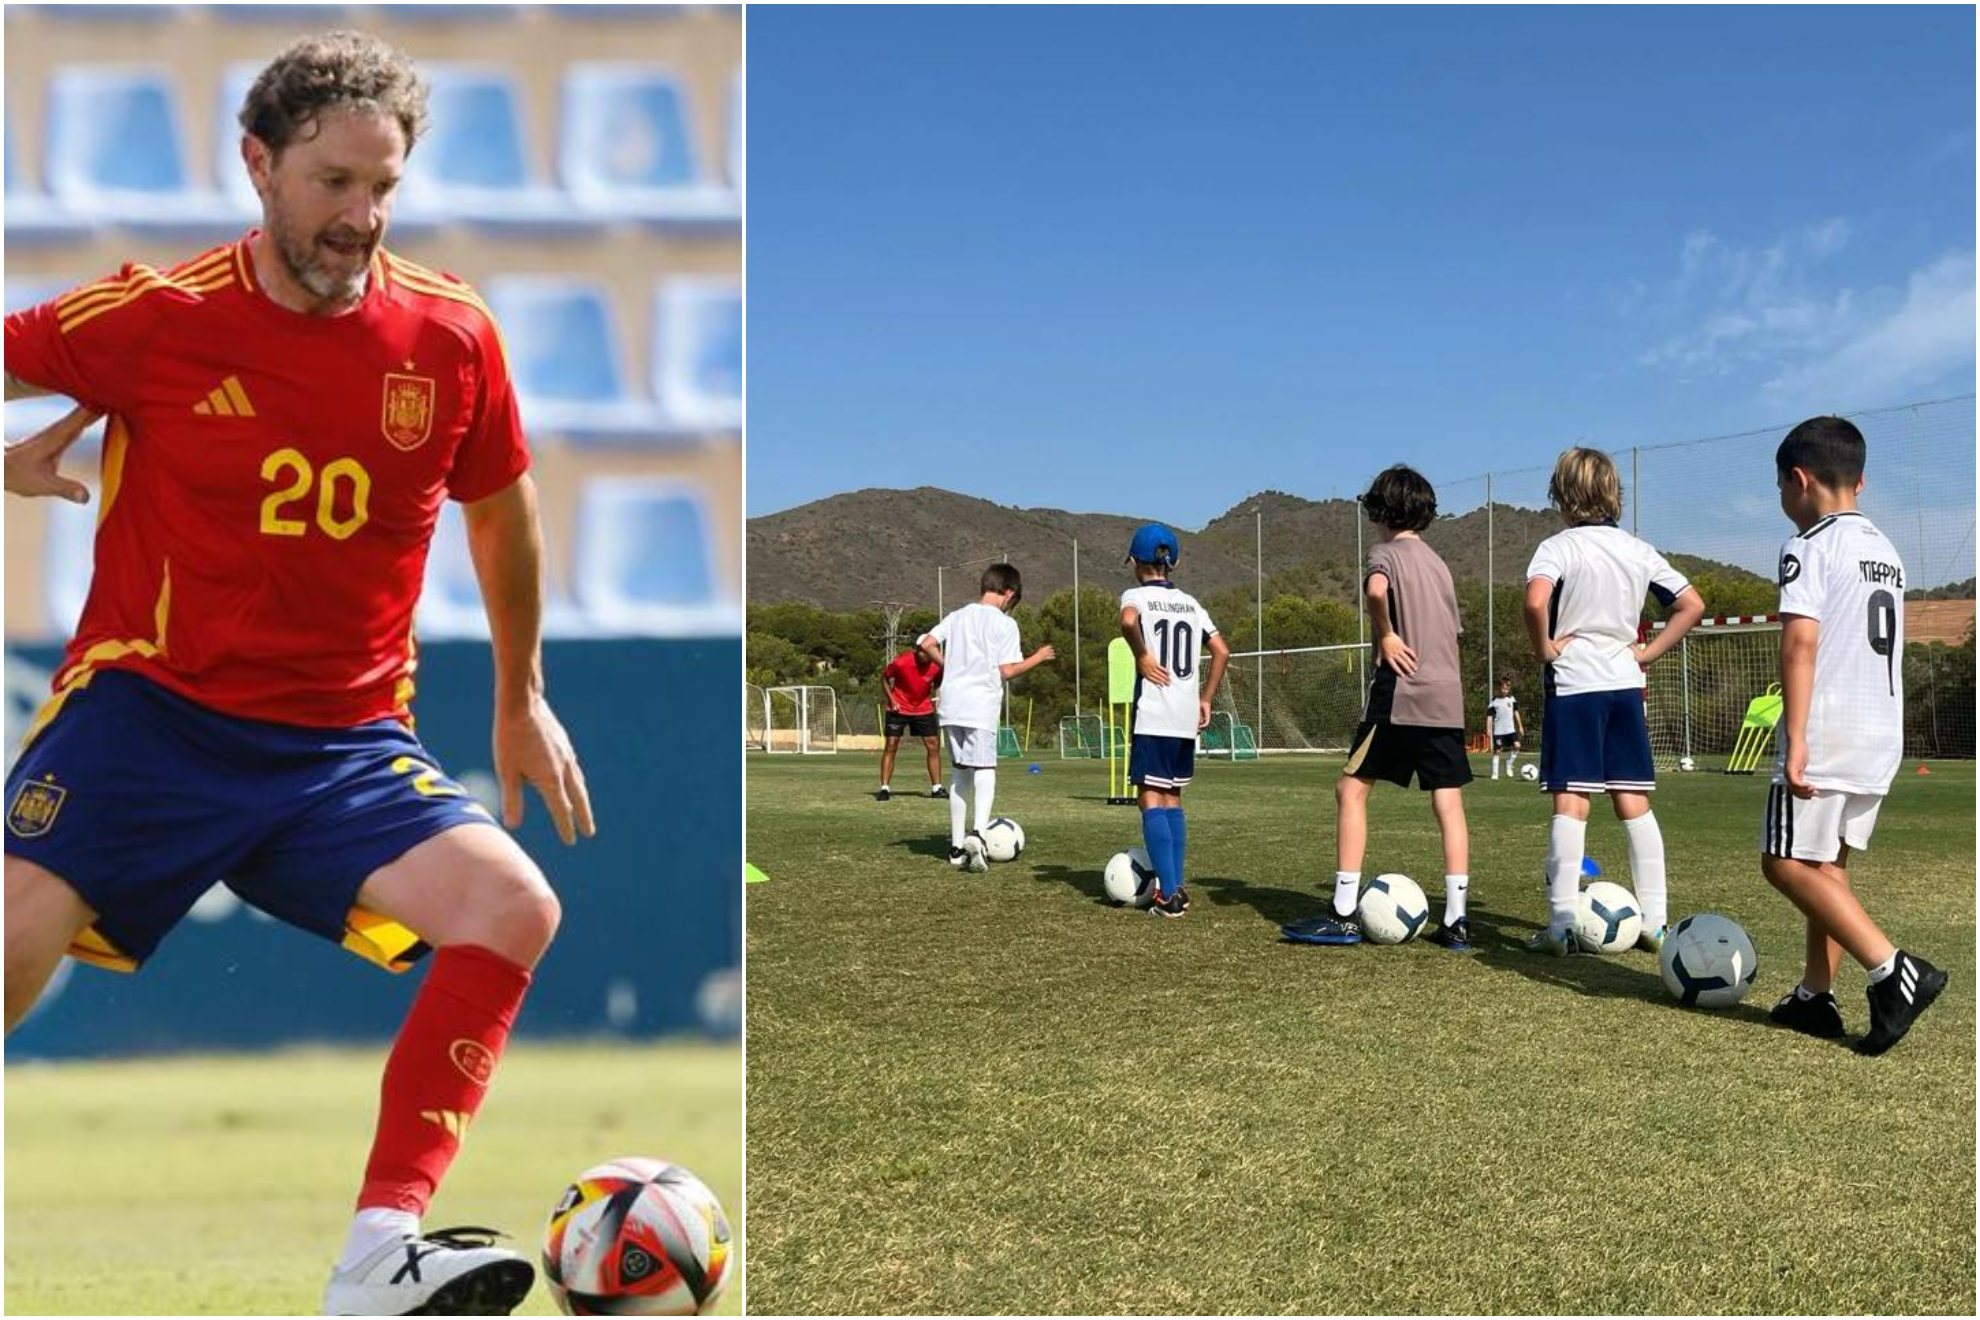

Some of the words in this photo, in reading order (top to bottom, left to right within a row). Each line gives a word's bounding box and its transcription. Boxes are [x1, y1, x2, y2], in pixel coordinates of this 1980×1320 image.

[260, 448, 371, 540] 20
[1147, 600, 1196, 614] BELLINGHAM
[1154, 618, 1193, 680] 10
[1867, 589, 1896, 697] 9
[391, 756, 491, 818] 2
